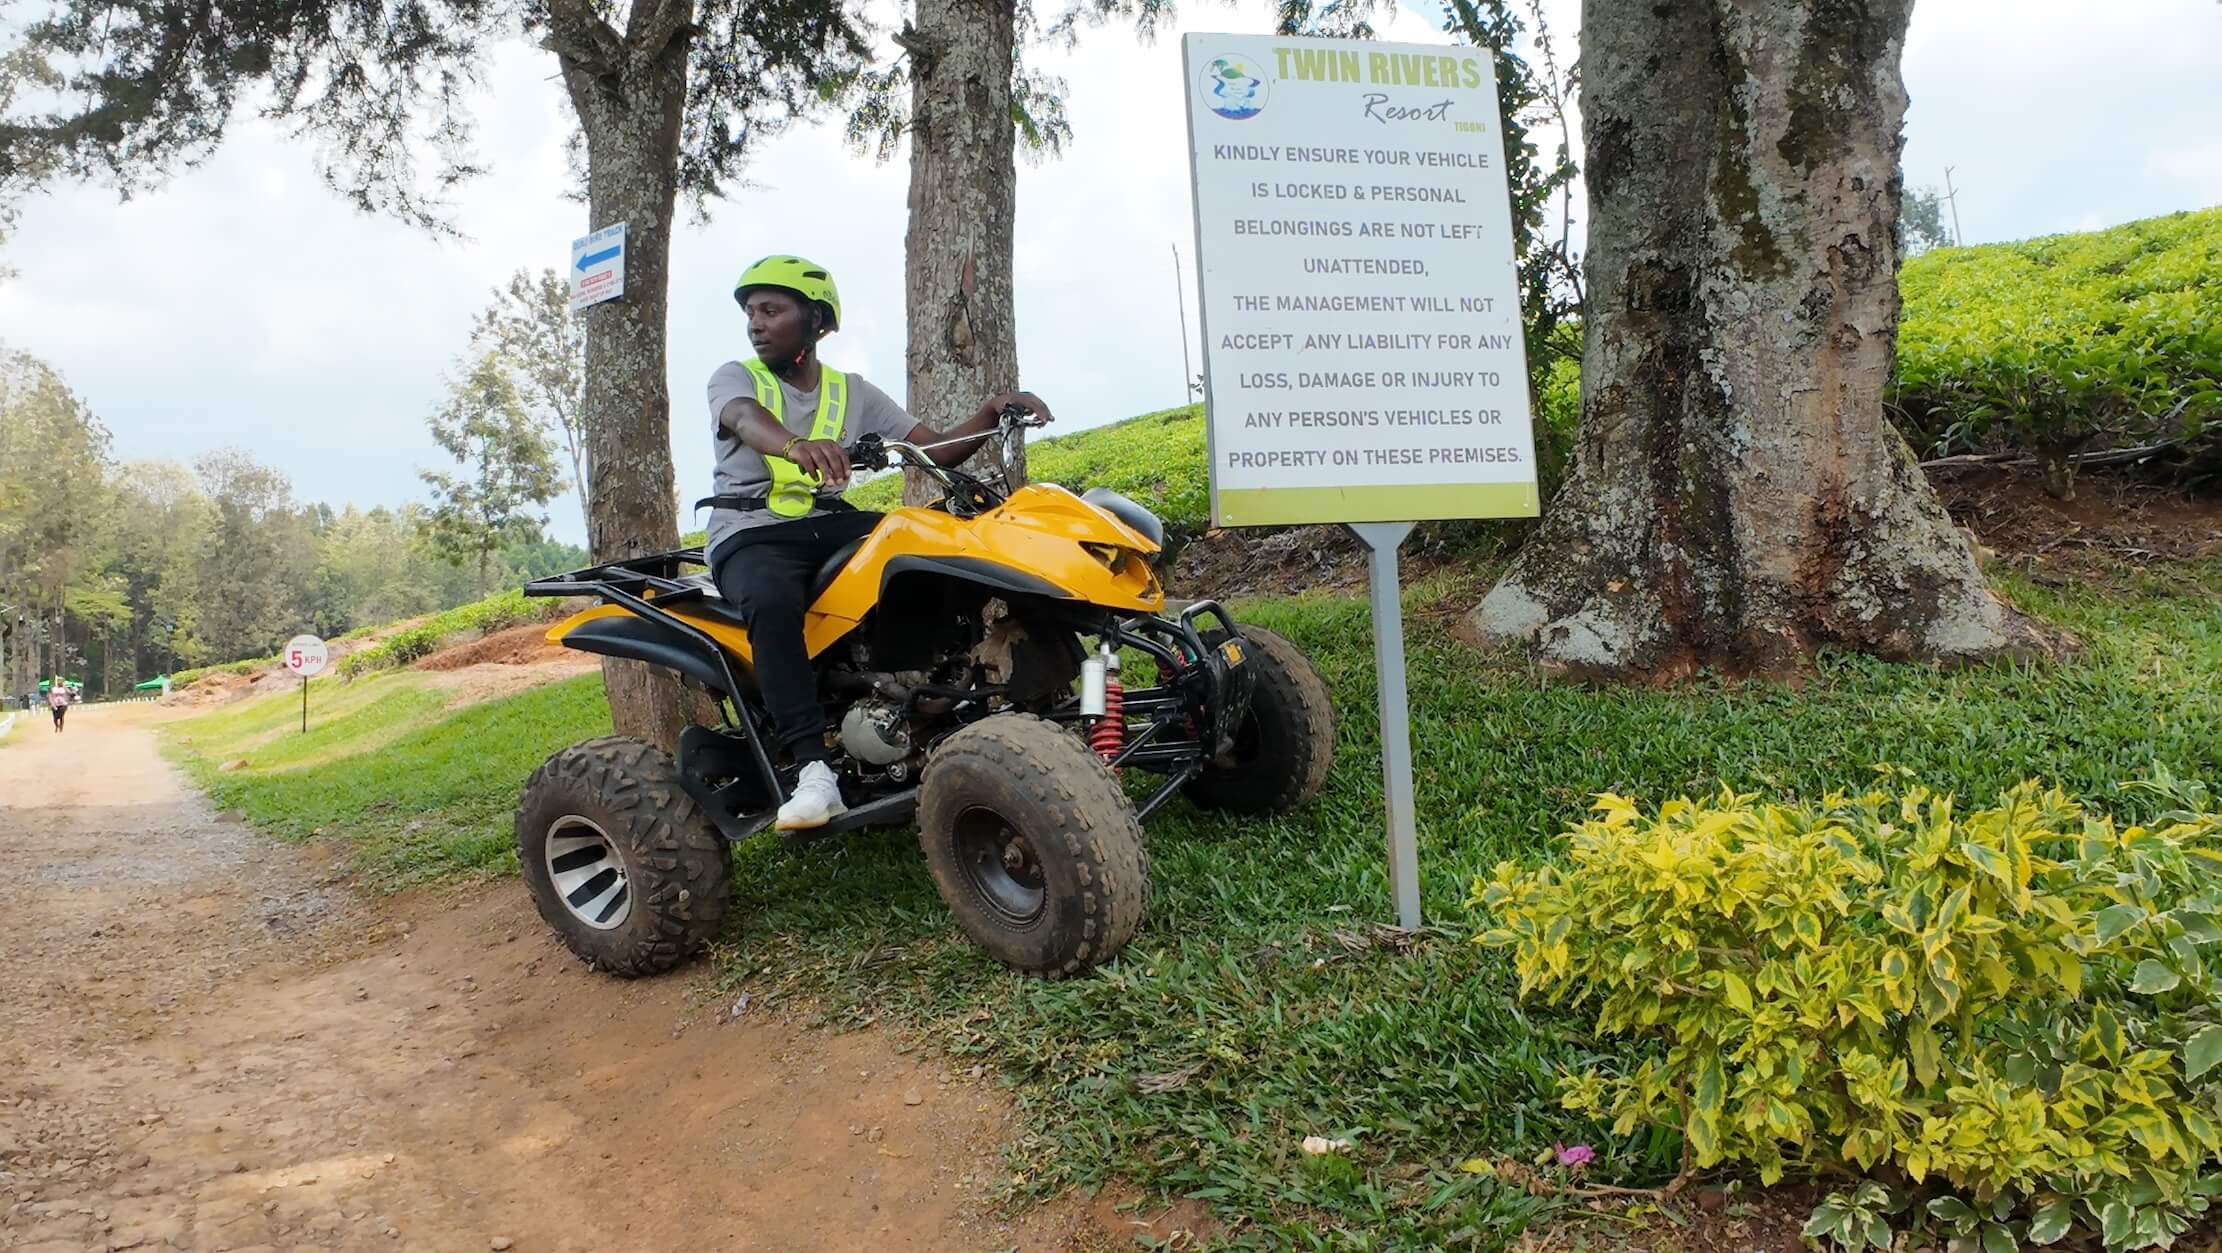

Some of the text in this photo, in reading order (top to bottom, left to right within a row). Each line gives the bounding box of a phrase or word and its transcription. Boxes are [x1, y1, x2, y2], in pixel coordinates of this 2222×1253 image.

[1272, 47, 1481, 89] TWIN RIVERS
[1362, 93, 1455, 124] Resort
[1214, 145, 1488, 168] KINDLY ENSURE YOUR VEHICLE
[1252, 182, 1466, 203] IS LOCKED & PERSONAL
[1234, 220, 1483, 239] BELONGINGS ARE NOT LEFT
[1304, 258, 1428, 277] UNATTENDED,
[1233, 296, 1494, 312] THE MANAGEMENT WILL NOT
[1222, 334, 1512, 349] ACCEPT ANY LIABILITY FOR ANY
[1240, 372, 1499, 390] LOSS, DAMAGE OR INJURY TO
[1245, 410, 1501, 428] ANY PERSON'S VEHICLES OR
[1229, 448, 1522, 468] PROPERTY ON THESE PREMISES.
[292, 650, 321, 668] 5 KPH
